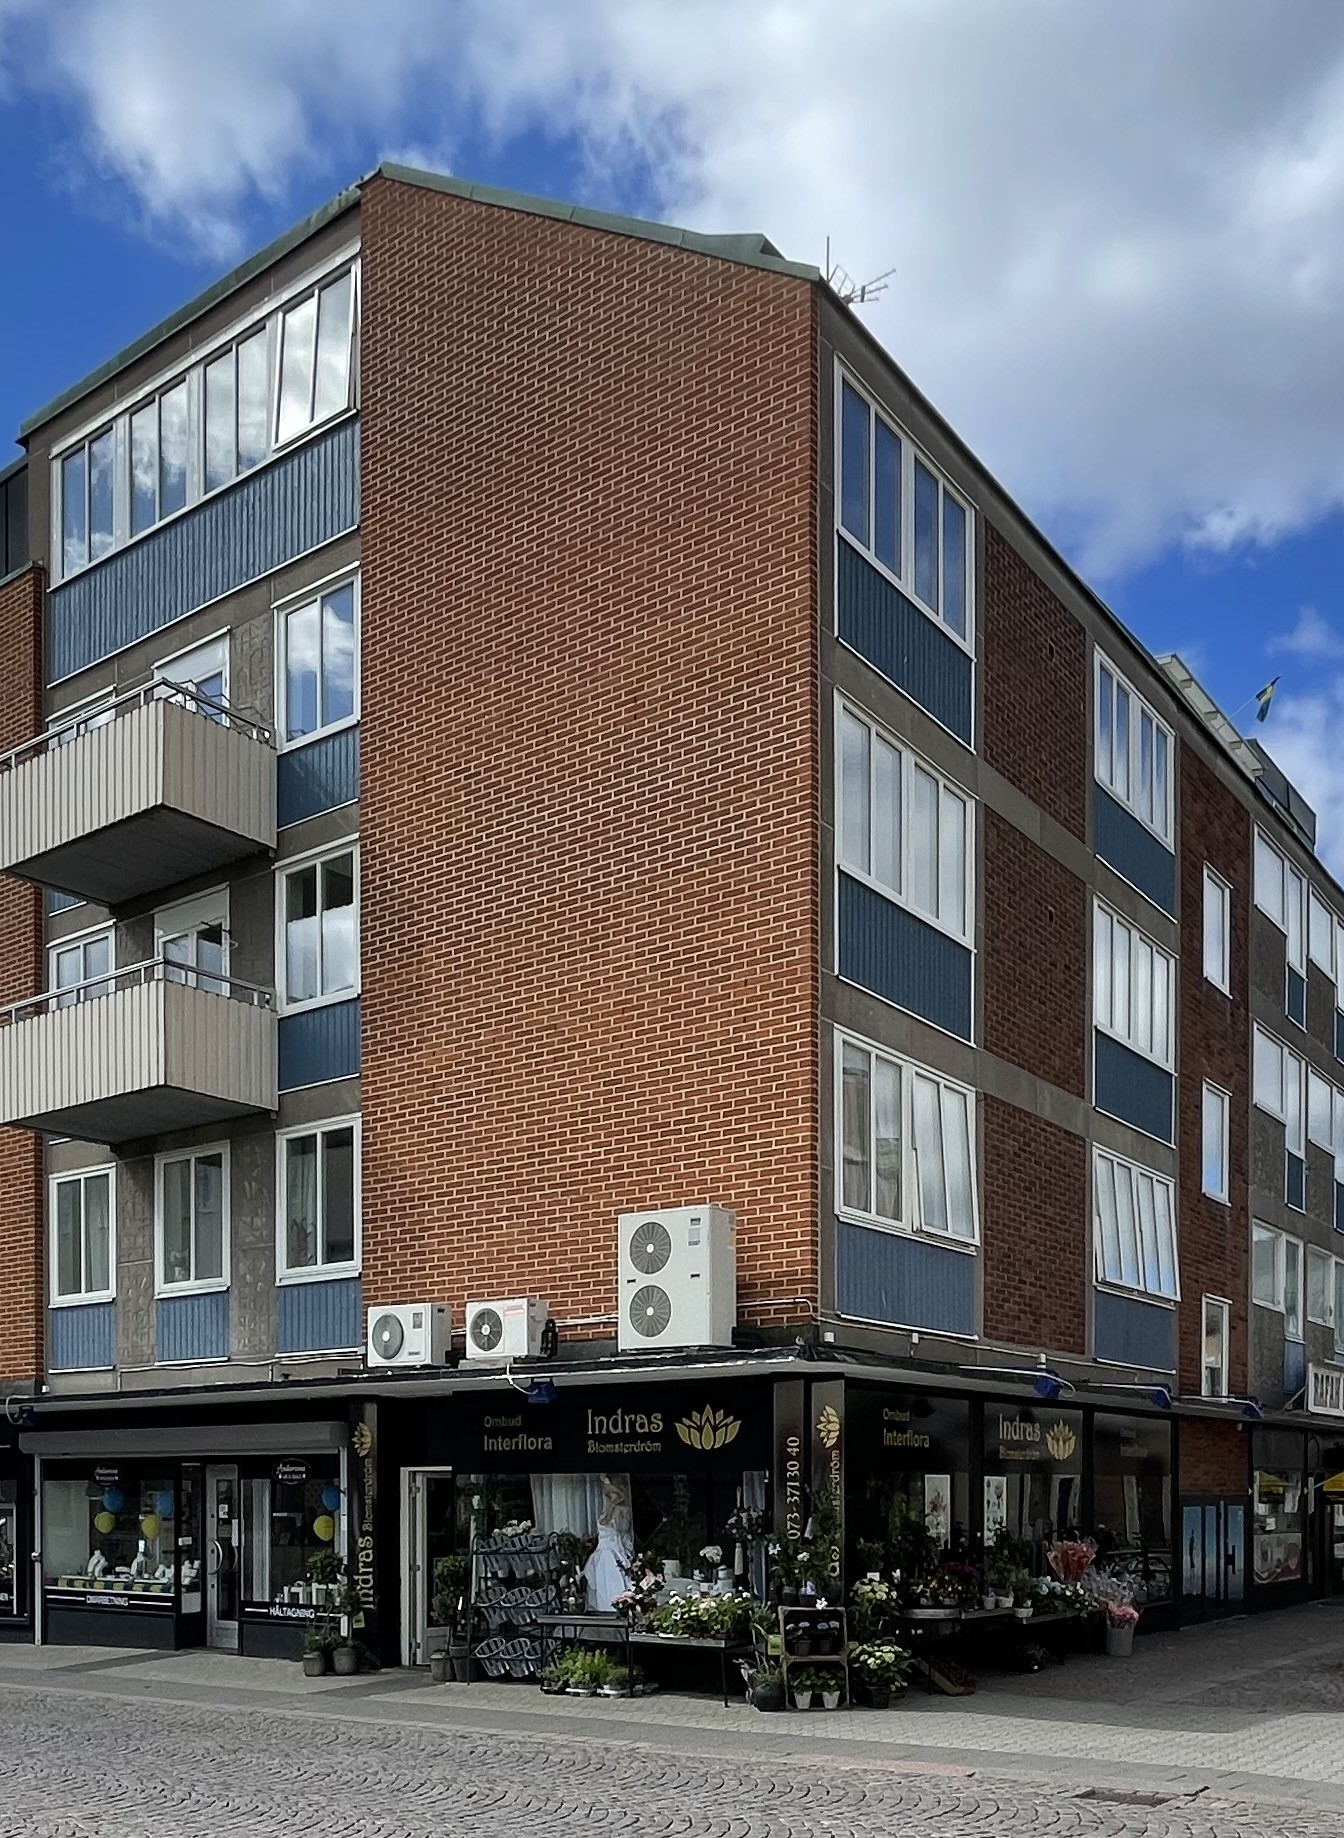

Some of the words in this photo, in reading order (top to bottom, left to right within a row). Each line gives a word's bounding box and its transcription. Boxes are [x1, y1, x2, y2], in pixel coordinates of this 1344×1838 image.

[484, 1415, 523, 1428] Ombud
[587, 1407, 664, 1435] Indras
[999, 1413, 1042, 1443] Indras
[484, 1434, 553, 1452] Interflora
[787, 1436, 800, 1457] 40
[883, 1428, 931, 1448] Interflora
[269, 1604, 315, 1619] HÅLTAGNING
